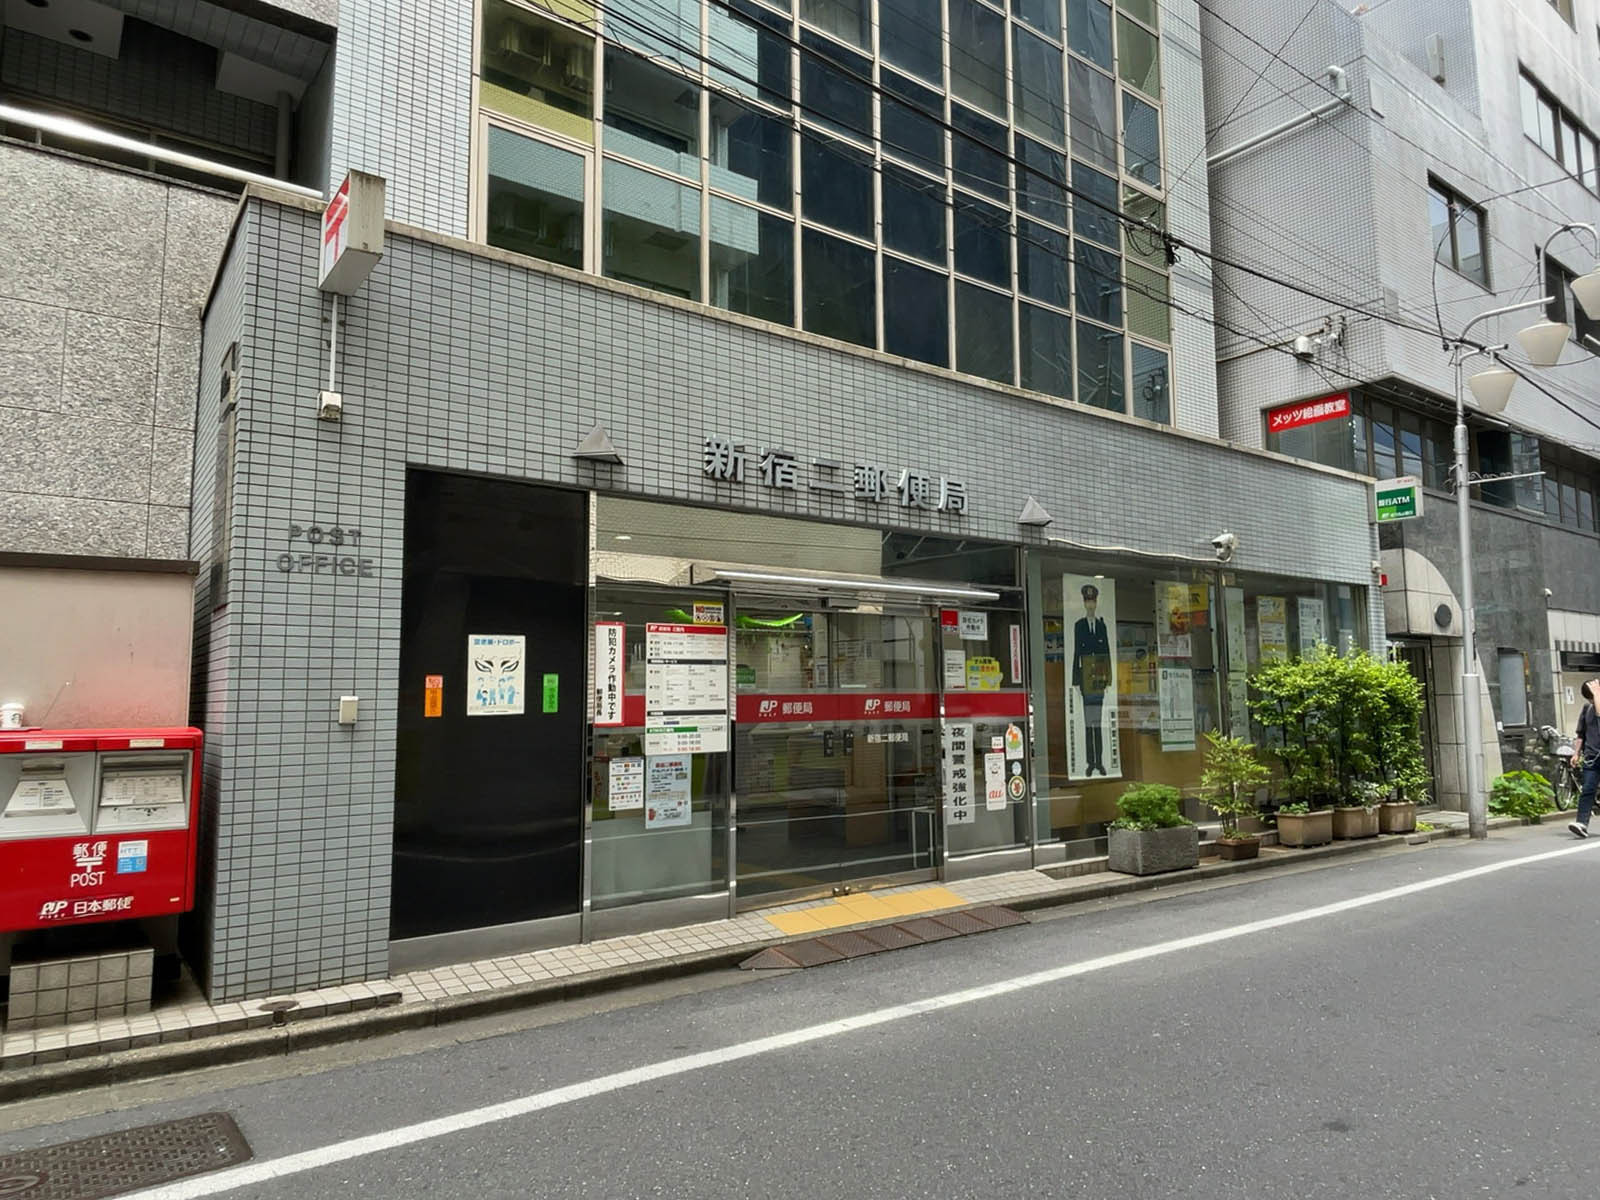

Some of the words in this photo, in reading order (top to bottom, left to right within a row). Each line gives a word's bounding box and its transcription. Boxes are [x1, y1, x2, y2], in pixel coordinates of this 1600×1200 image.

[1272, 399, 1346, 427] メッツ絵画教室
[704, 435, 969, 516] 新宿二郵便局
[289, 524, 361, 547] POST
[277, 553, 373, 577] OFFICE
[608, 628, 616, 720] 防犯カメラ作動中です
[782, 702, 813, 715] 郵便局
[884, 700, 911, 713] 郵便局
[951, 727, 967, 820] 夜間警戒強化中
[73, 841, 108, 859] 郵便
[70, 871, 106, 888] POST
[73, 896, 135, 915] 日本郵便
